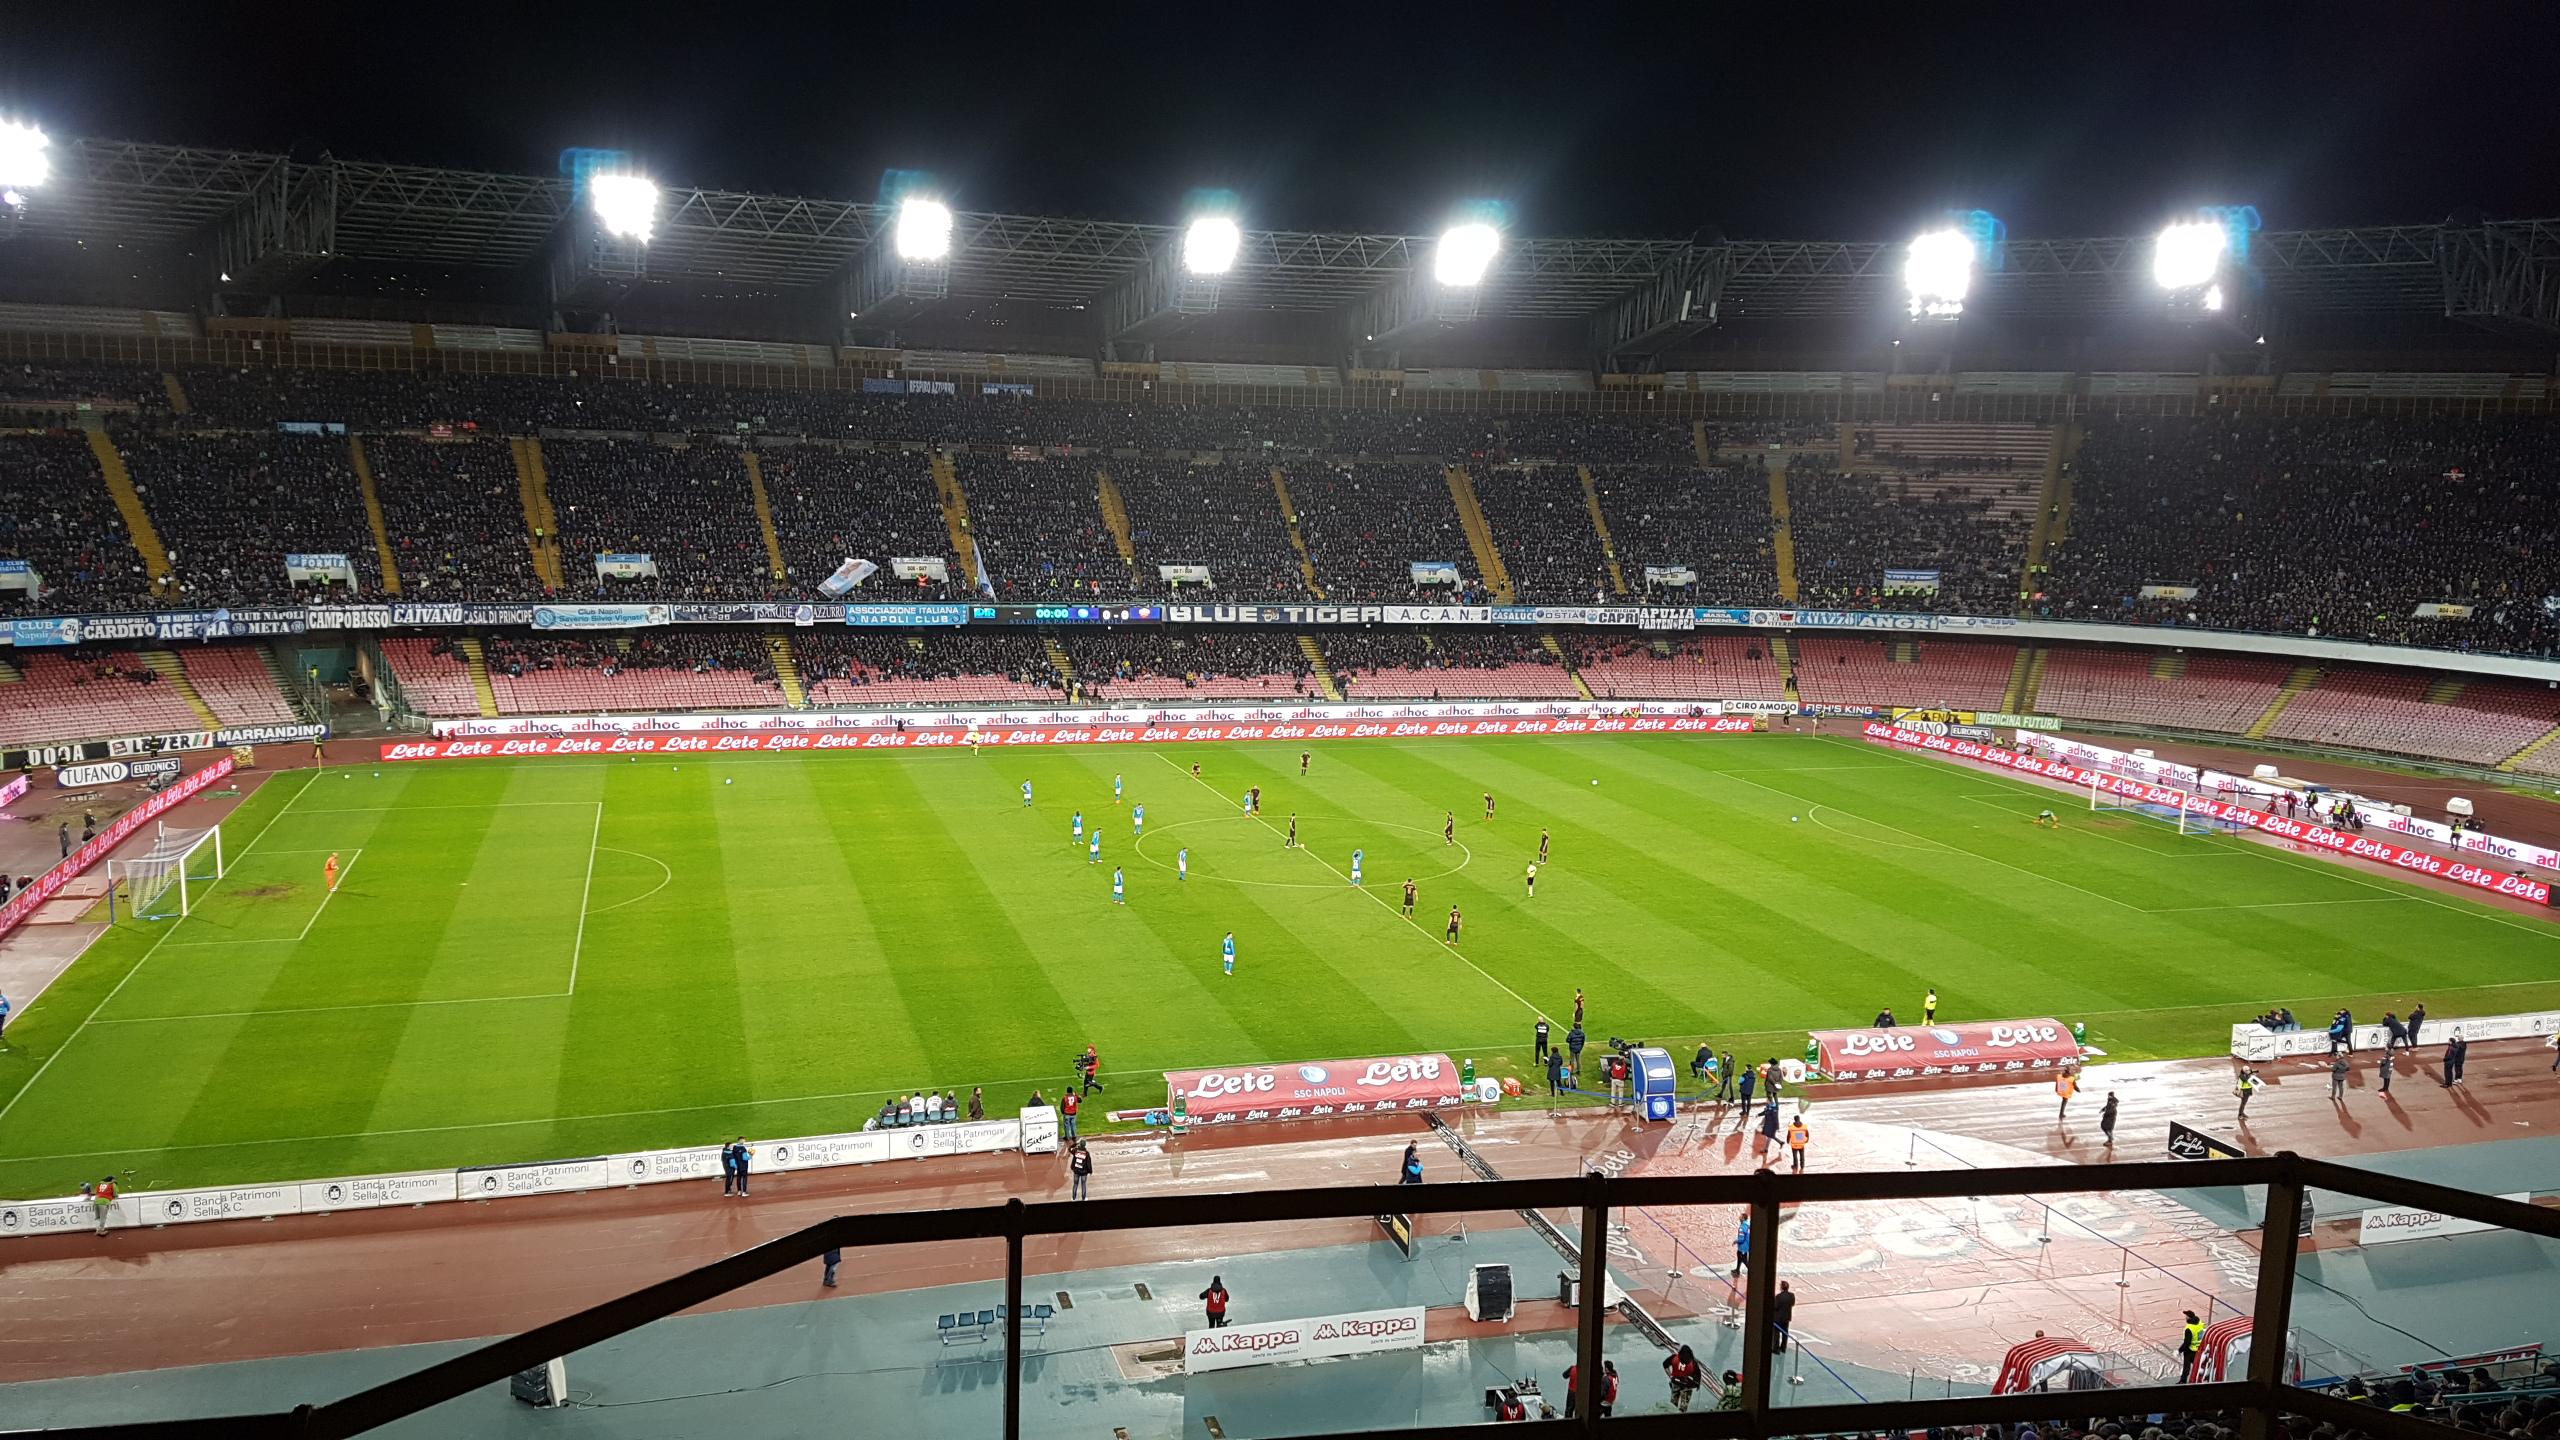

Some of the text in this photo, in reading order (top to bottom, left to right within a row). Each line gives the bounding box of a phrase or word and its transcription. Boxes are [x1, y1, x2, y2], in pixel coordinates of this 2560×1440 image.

[301, 559, 346, 567] FORMIA
[231, 610, 304, 621] CLUB NAPOLI
[394, 608, 463, 623] CAIVANO
[463, 609, 533, 624] CASAL DI PRINCIPE
[598, 608, 623, 616] Napoli
[813, 606, 846, 617] AZZURRO
[848, 606, 958, 614] ASSOCIAZIONE ITALIANA
[1035, 608, 1069, 619] 00:00
[1102, 610, 1111, 620] 0
[1169, 606, 1381, 623] BLUE TIGER
[1639, 608, 1695, 619] APULIA
[18, 621, 54, 630] CLUB
[309, 611, 389, 628] CAMPOBASSO
[860, 614, 949, 623] NAPOLI CLUB
[1598, 613, 1639, 624] CAPRI
[1859, 616, 1938, 630] ANGRI
[83, 622, 156, 639] CARDITO
[160, 621, 230, 638] ACERA
[248, 621, 290, 634] META
[15, 631, 49, 640] Napoli
[1735, 702, 1797, 711] CIRO AMODIO
[1845, 706, 1873, 715] KING
[509, 705, 1520, 733] adhoc adhoc adhoc adhoc adhoc adhoc adhoc adhoc
[1978, 711, 2060, 730] MEDICINA FUTURA
[216, 724, 326, 742] MARRANDINO
[1900, 720, 1944, 736] TUFANO
[1952, 727, 1989, 737] EURONICS
[385, 718, 1750, 759] Lete Lete Lete Lete Lete Lete Lete Lete Lete
[133, 759, 177, 774] EURONICS
[65, 764, 122, 785] TUFANO
[2067, 745, 2517, 858] adhoc adhoc adhoc adhoc adhoc
[1864, 722, 2546, 901] Lete Lete Lete Lete Lete
[1986, 1024, 2058, 1048] Lete
[1840, 1033, 1916, 1056] Lete
[1934, 1048, 1979, 1058] SSC NAPOLI
[1357, 1056, 1441, 1086] Lete
[1836, 1056, 2077, 1080] Lete Lete Lete Lete
[1187, 1069, 1275, 1099] Lete
[1293, 1086, 1346, 1099] SSC NAPOLI
[1212, 1095, 1459, 1123] Lete Lete Lete Lete
[798, 1141, 873, 1153] Banca Patrimoni
[656, 1152, 720, 1165] Banca Patrim
[798, 1152, 820, 1161] Sella
[822, 1153, 830, 1162] &
[656, 1165, 679, 1175] Sella
[682, 1164, 689, 1173] &
[352, 1178, 438, 1191] Banca Patrimoni
[193, 1189, 281, 1207] Banca Patrimoni
[353, 1190, 378, 1201] Sella
[381, 1190, 389, 1199] &
[28, 1202, 120, 1217] Banca Patrini
[193, 1206, 220, 1217] Sella
[223, 1203, 232, 1213] &
[29, 1217, 57, 1228] Sella
[59, 1217, 68, 1226] &
[2386, 1211, 2442, 1228] Kappa
[1341, 1316, 1416, 1338] Kappa
[1222, 1329, 1299, 1351] Kappa
